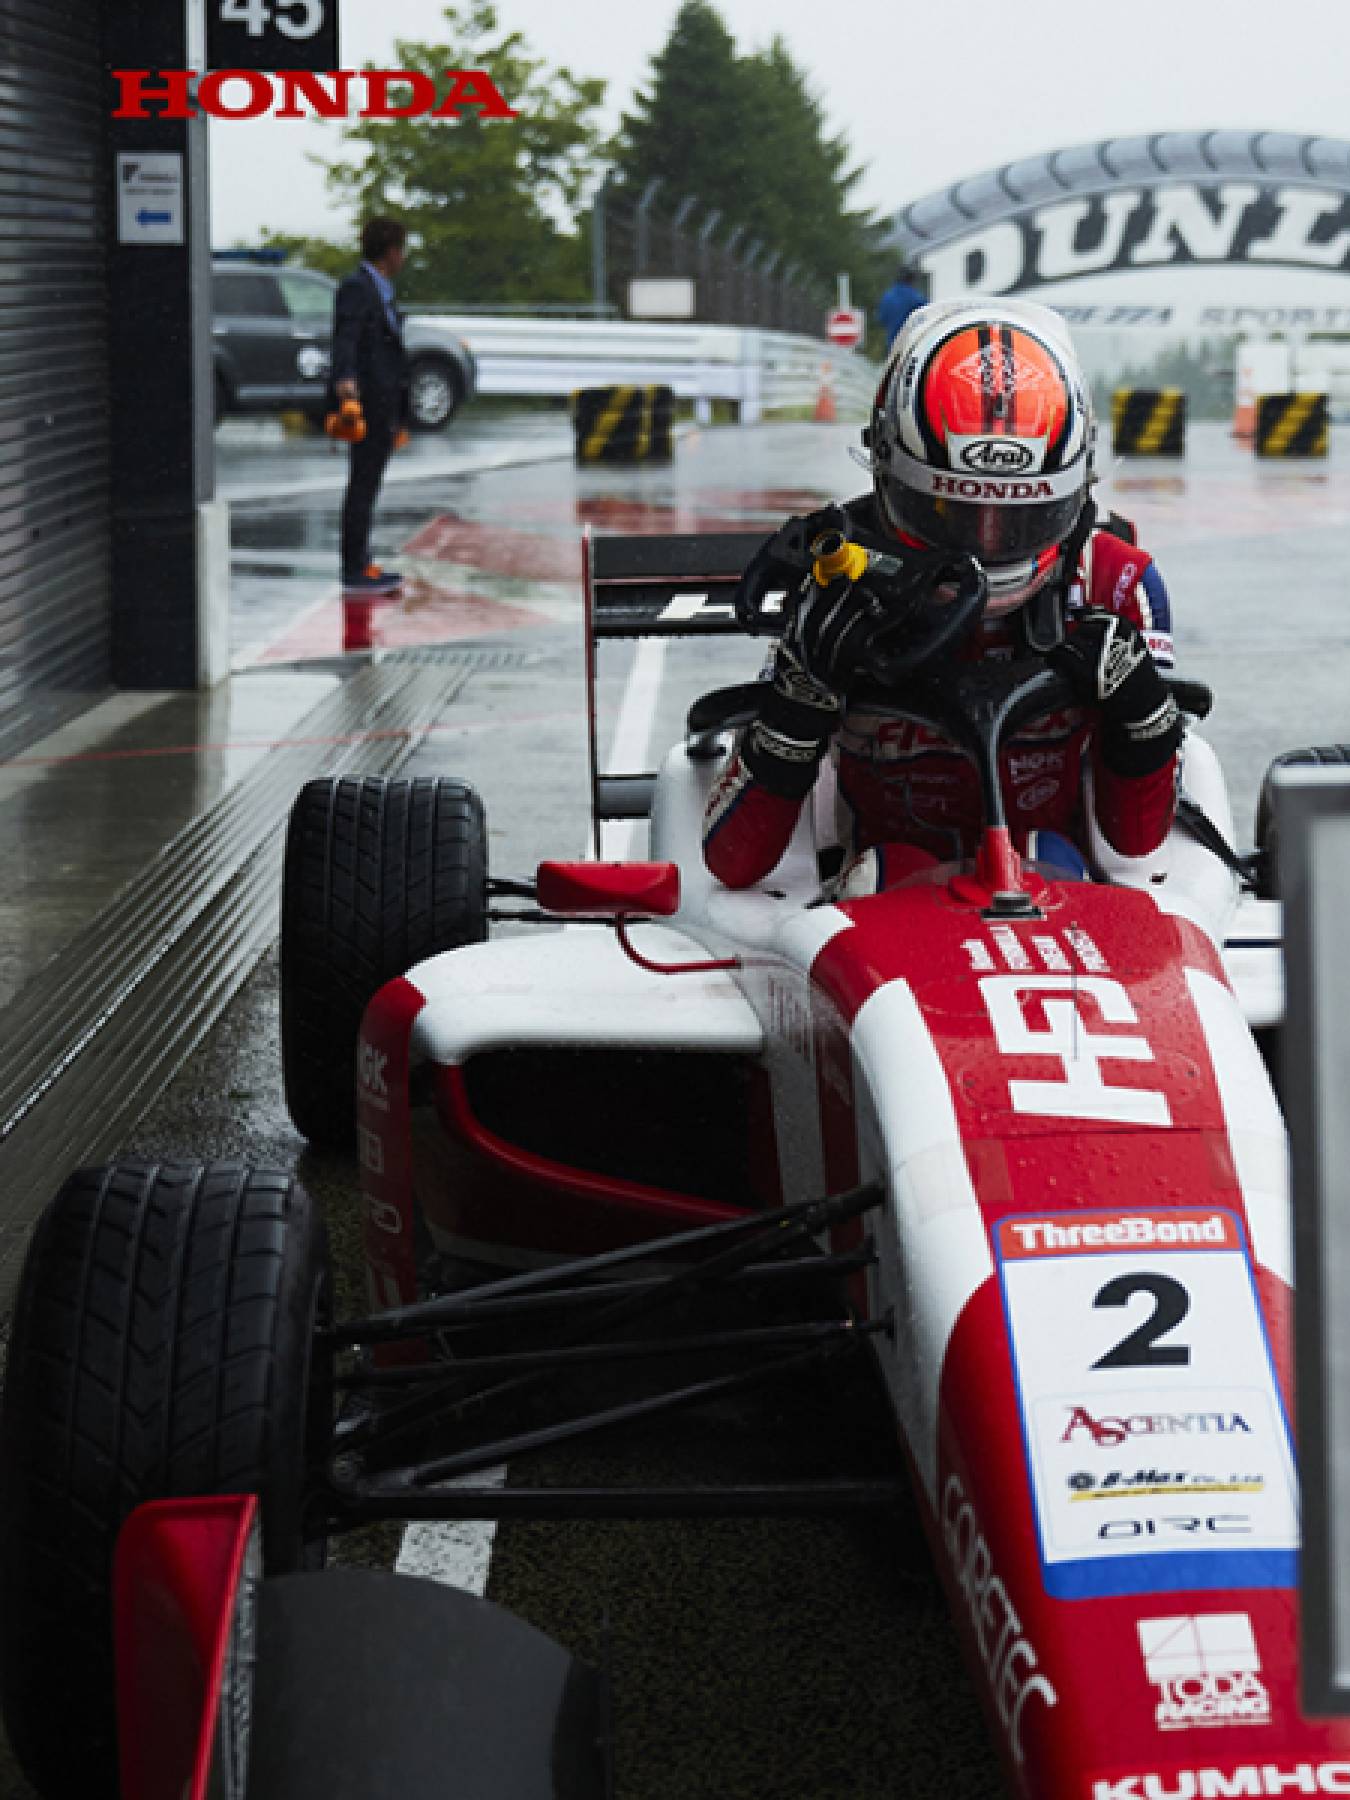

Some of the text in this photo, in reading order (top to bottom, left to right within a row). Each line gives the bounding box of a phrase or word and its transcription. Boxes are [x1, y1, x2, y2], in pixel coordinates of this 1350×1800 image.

[964, 442, 1031, 469] Arai
[932, 474, 1054, 499] HONDA
[1011, 1215, 1226, 1251] ThreeBond
[1088, 1271, 1191, 1371] 2
[1149, 1671, 1265, 1706] TODA
